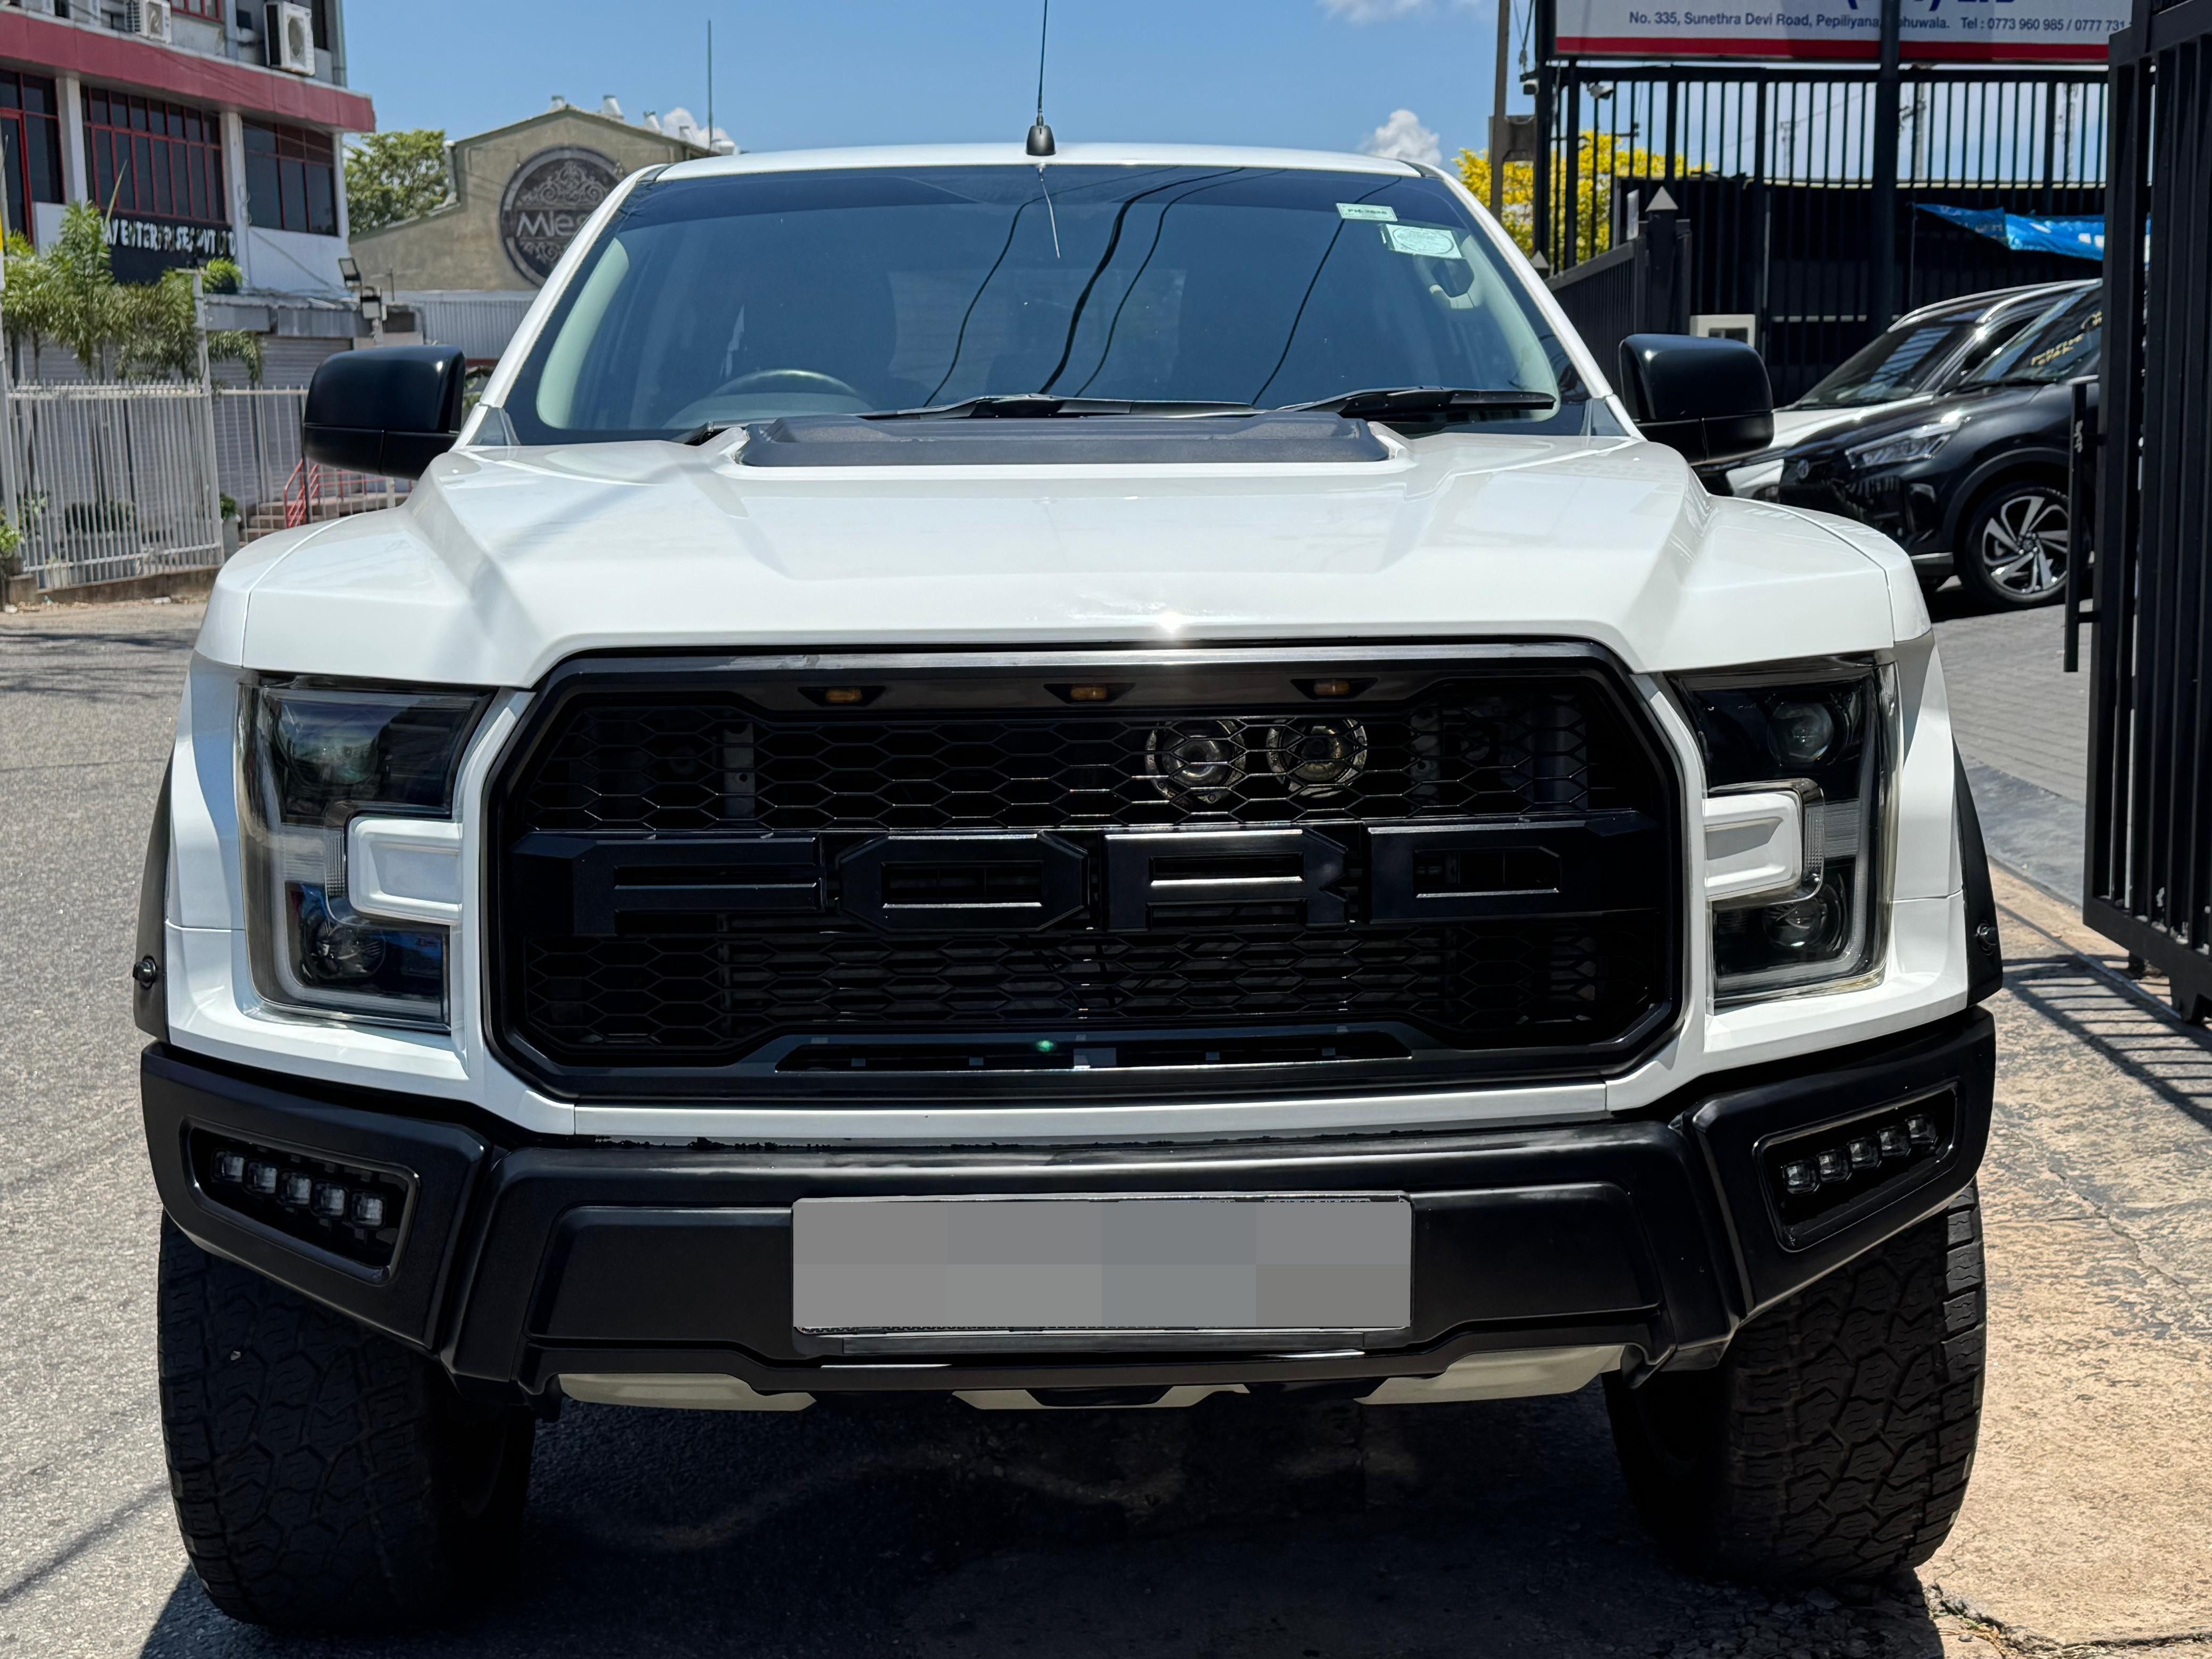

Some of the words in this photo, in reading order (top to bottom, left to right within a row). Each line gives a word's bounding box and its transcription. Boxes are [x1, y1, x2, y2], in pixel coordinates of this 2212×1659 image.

[1629, 11, 1650, 24] No.
[1655, 12, 1680, 26] 335,
[1684, 12, 1741, 25] Sunethra
[1746, 13, 1772, 26] Devi
[1777, 13, 1812, 27] Road,
[1987, 18, 2016, 30] 0773
[2019, 19, 2040, 30] 960
[2043, 20, 2064, 30] 985
[2075, 20, 2102, 31] 0777
[542, 819, 1606, 937] FORD
